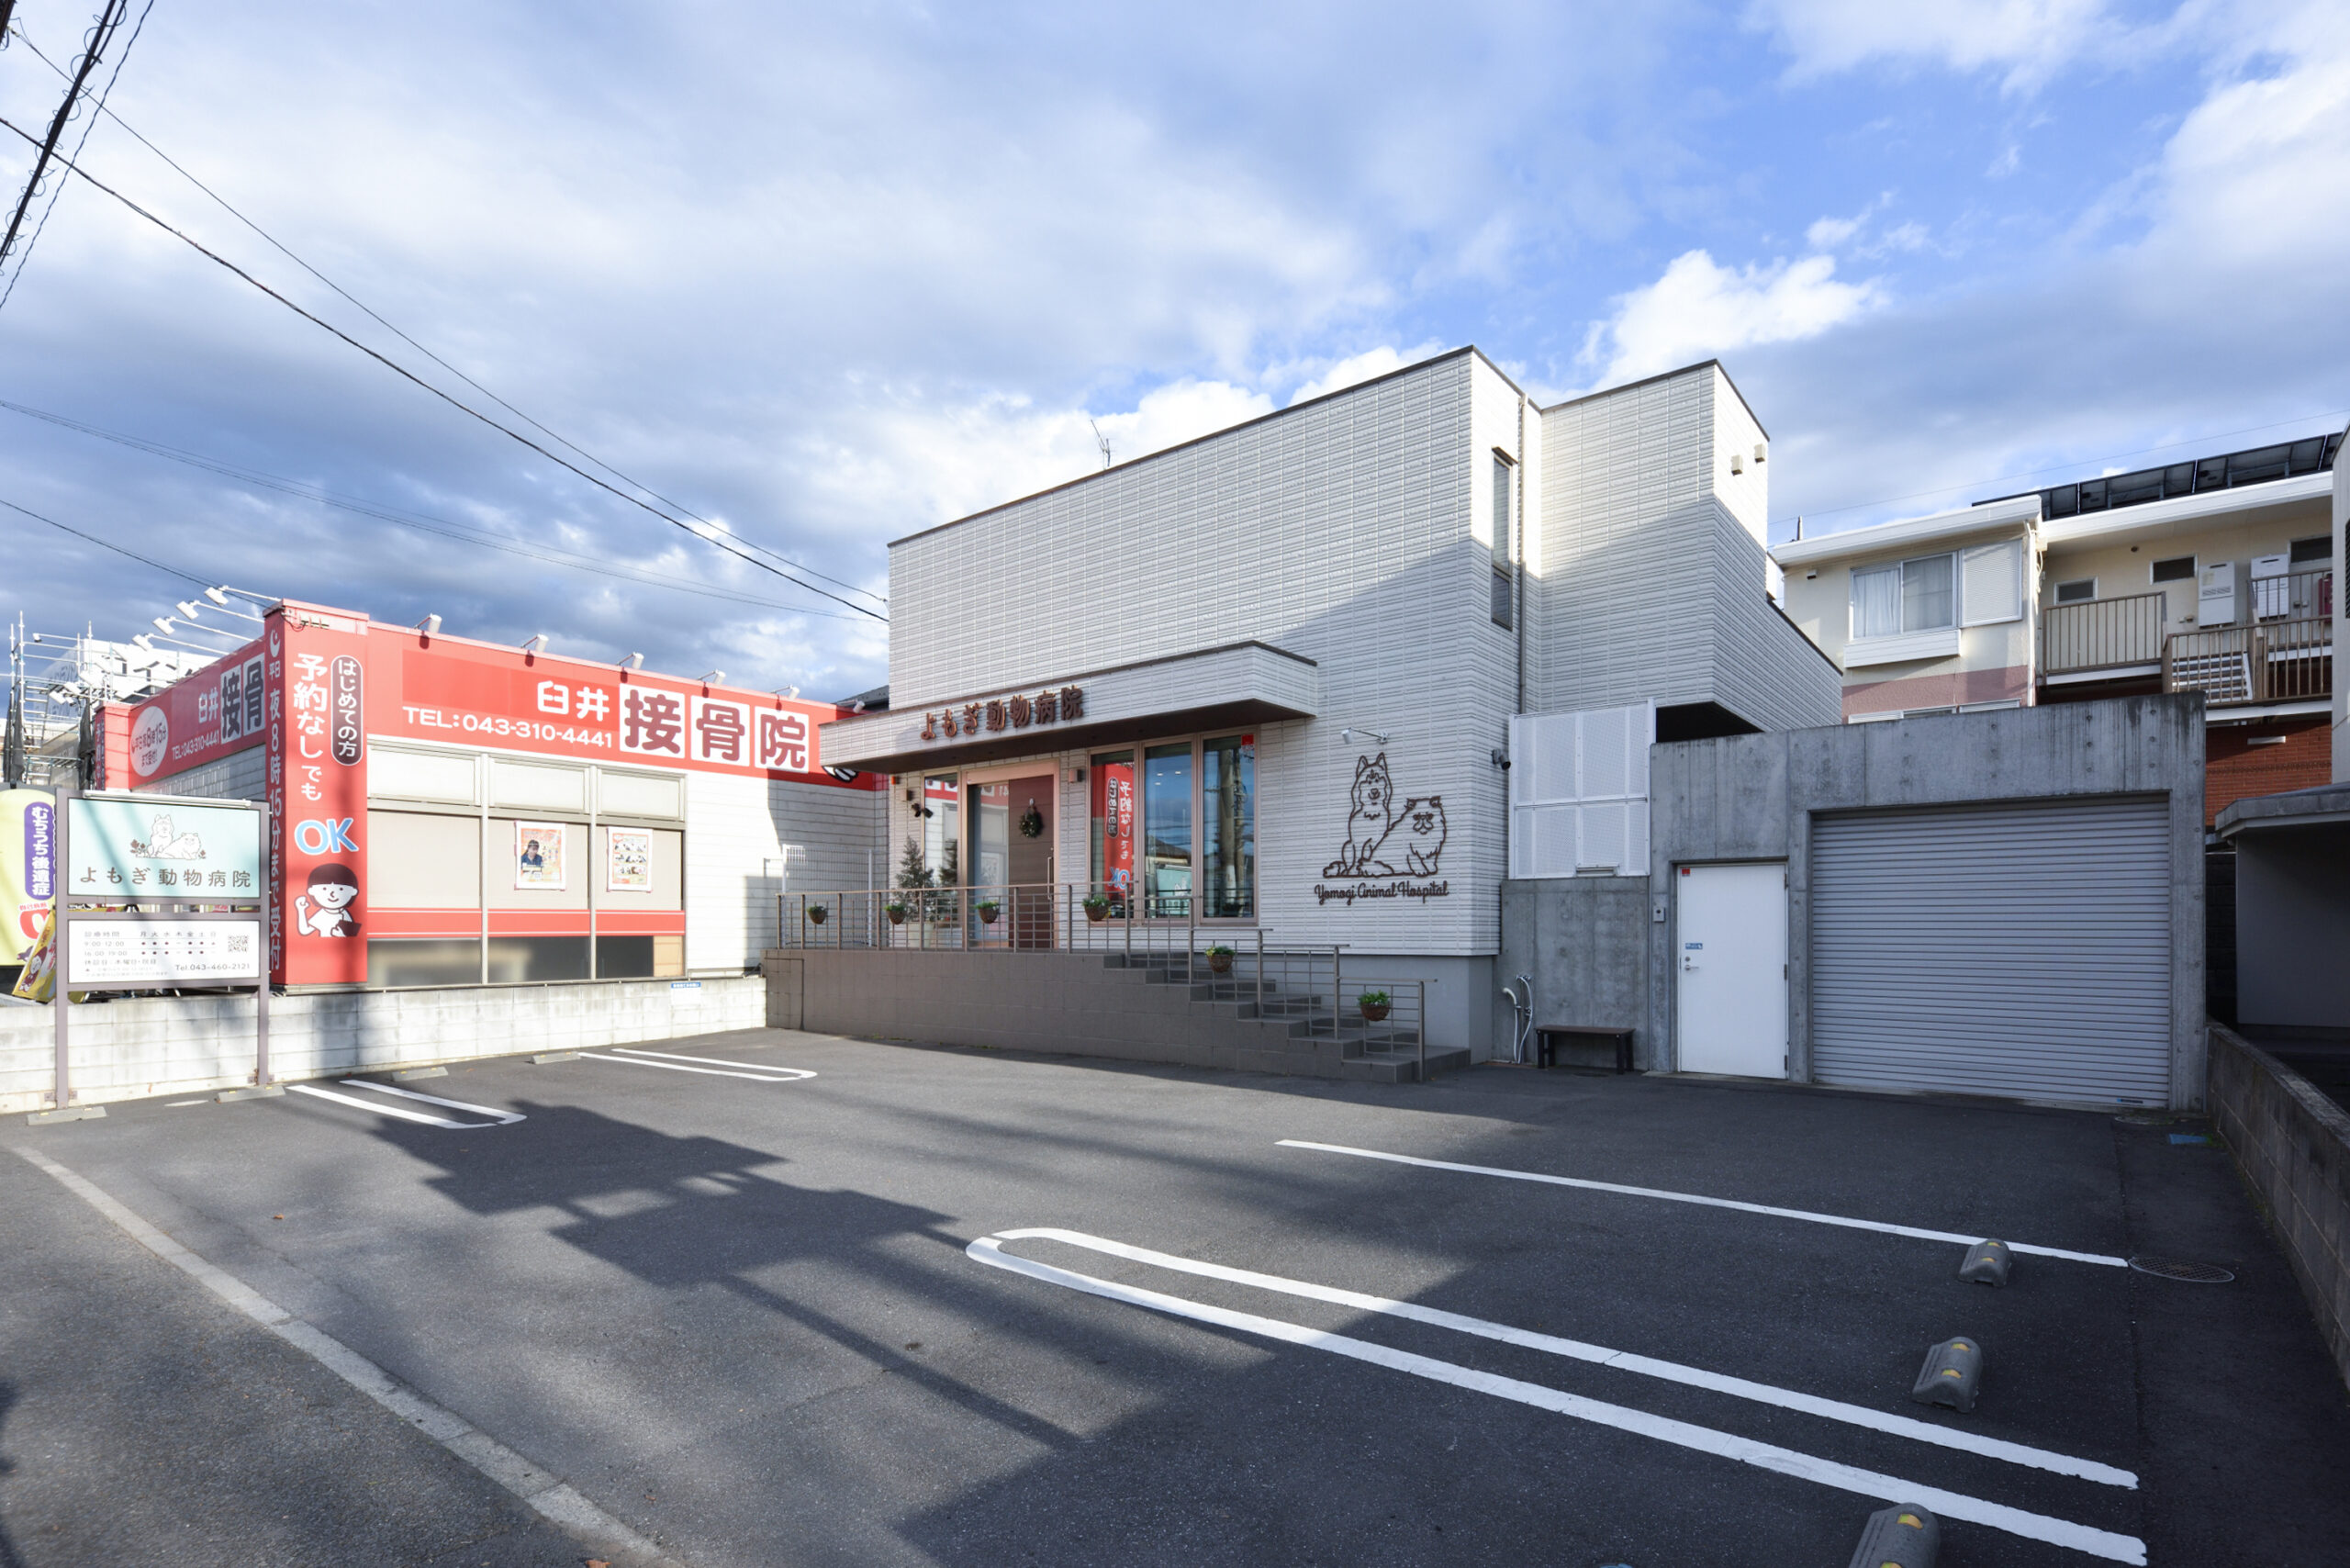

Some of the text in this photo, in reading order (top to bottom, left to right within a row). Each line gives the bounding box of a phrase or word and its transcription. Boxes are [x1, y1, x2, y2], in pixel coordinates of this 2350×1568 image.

[293, 653, 329, 801] 予約なしでも
[337, 659, 358, 757] はじめての方
[624, 689, 807, 769] 接骨院
[921, 684, 1083, 740] よもぎ動物病院
[294, 817, 360, 856] OK
[80, 867, 252, 888] よもぎ動物病院
[1314, 884, 1356, 905] Yomogi
[1397, 880, 1449, 903] Hospital
